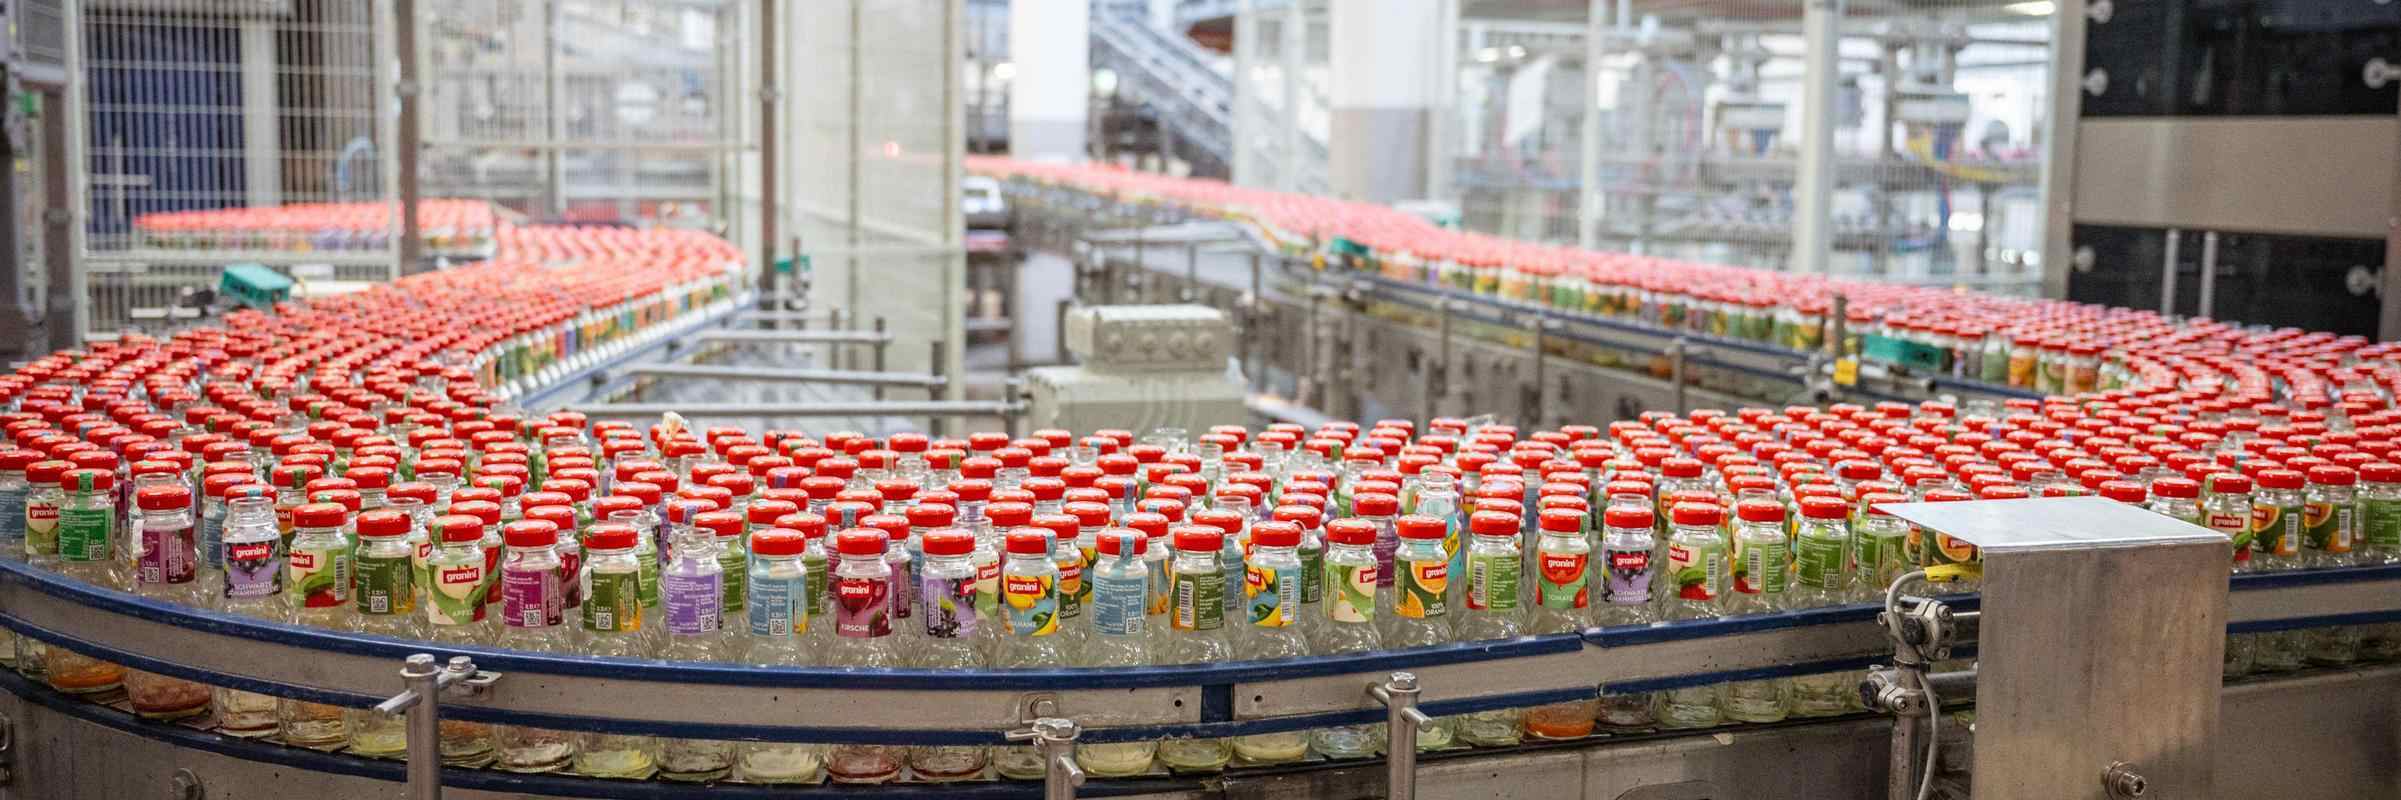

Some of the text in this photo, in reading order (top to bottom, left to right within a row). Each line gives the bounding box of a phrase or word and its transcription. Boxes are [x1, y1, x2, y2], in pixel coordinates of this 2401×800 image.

[236, 546, 268, 558] granini
[1548, 559, 1576, 568] granini
[1616, 555, 1645, 566] granini
[446, 569, 478, 583] granini
[840, 585, 870, 595] granini
[1009, 582, 1038, 592] granini
